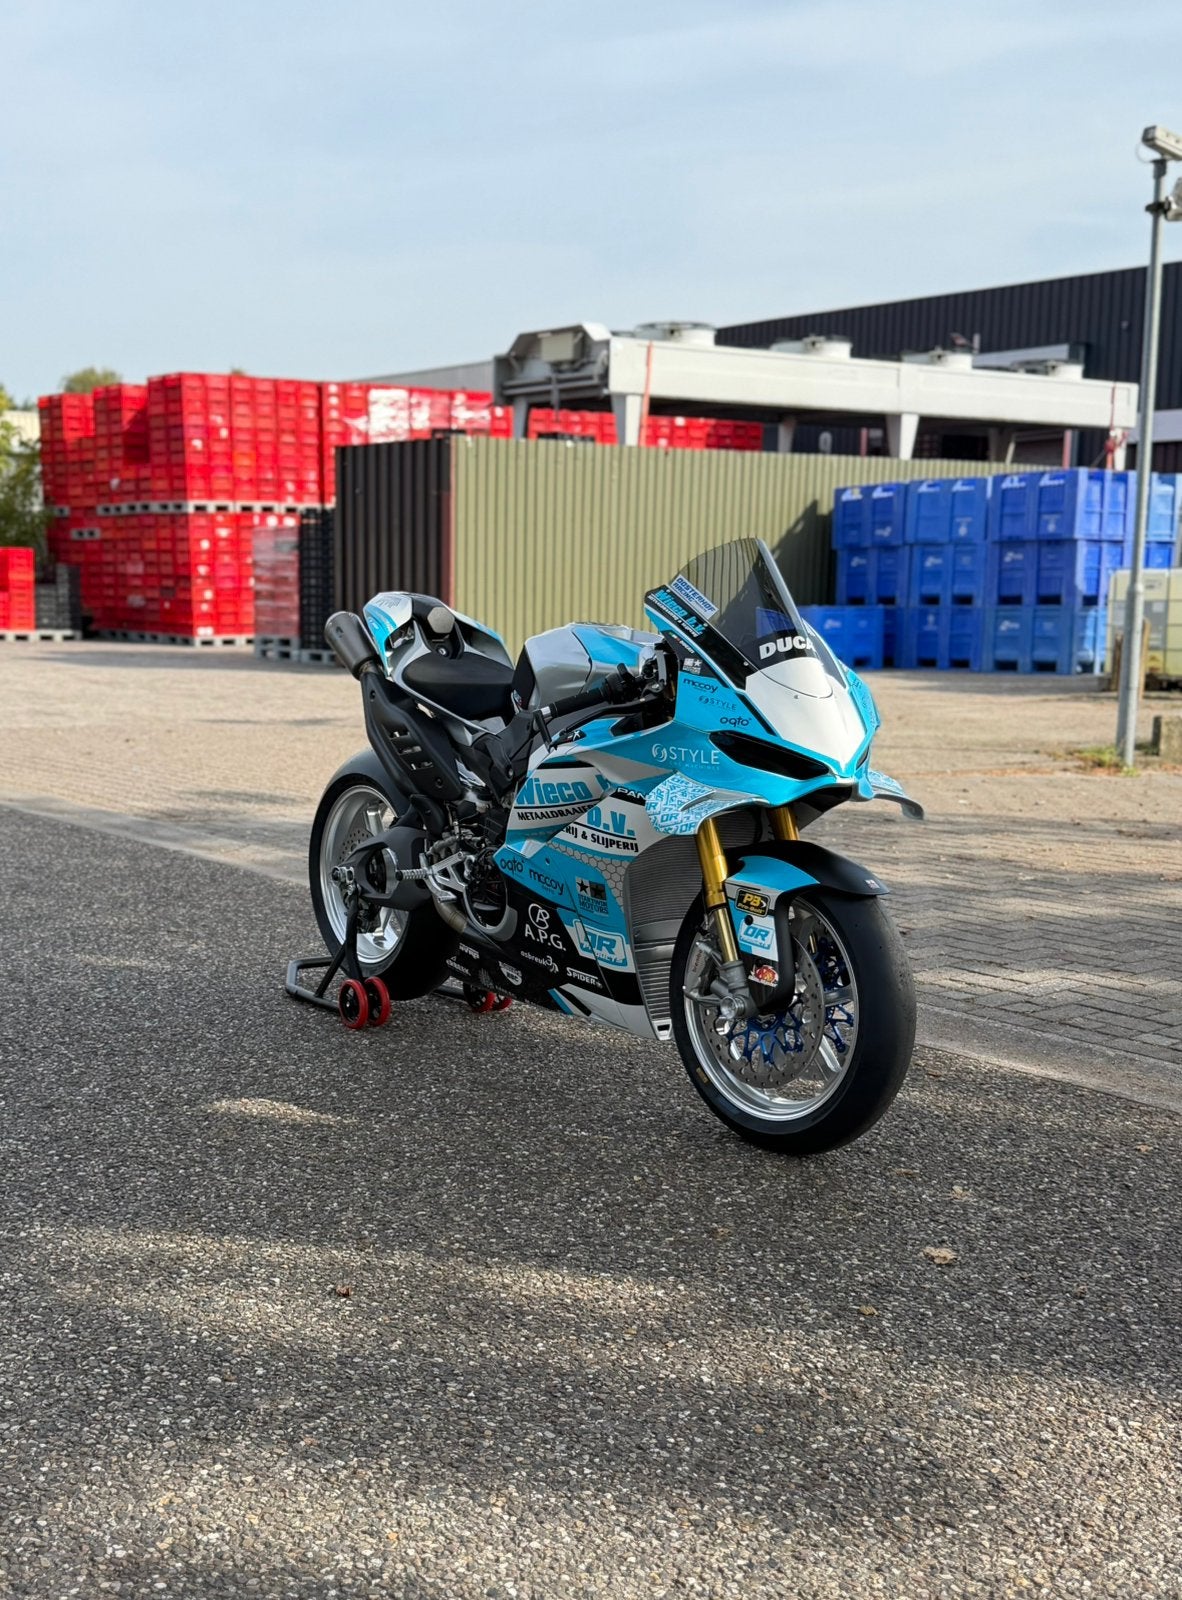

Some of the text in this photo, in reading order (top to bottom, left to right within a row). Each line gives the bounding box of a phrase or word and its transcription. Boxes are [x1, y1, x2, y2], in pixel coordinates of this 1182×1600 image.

[682, 678, 719, 694] mccoy
[710, 698, 737, 711] STYLE
[669, 746, 720, 765] STYLE
[581, 830, 588, 841] &
[591, 833, 639, 853] SLIJPERIJ
[529, 868, 564, 896] mccoy
[743, 893, 762, 907] PB
[525, 923, 567, 952] A.P.G.
[566, 966, 598, 985] SPIDER
